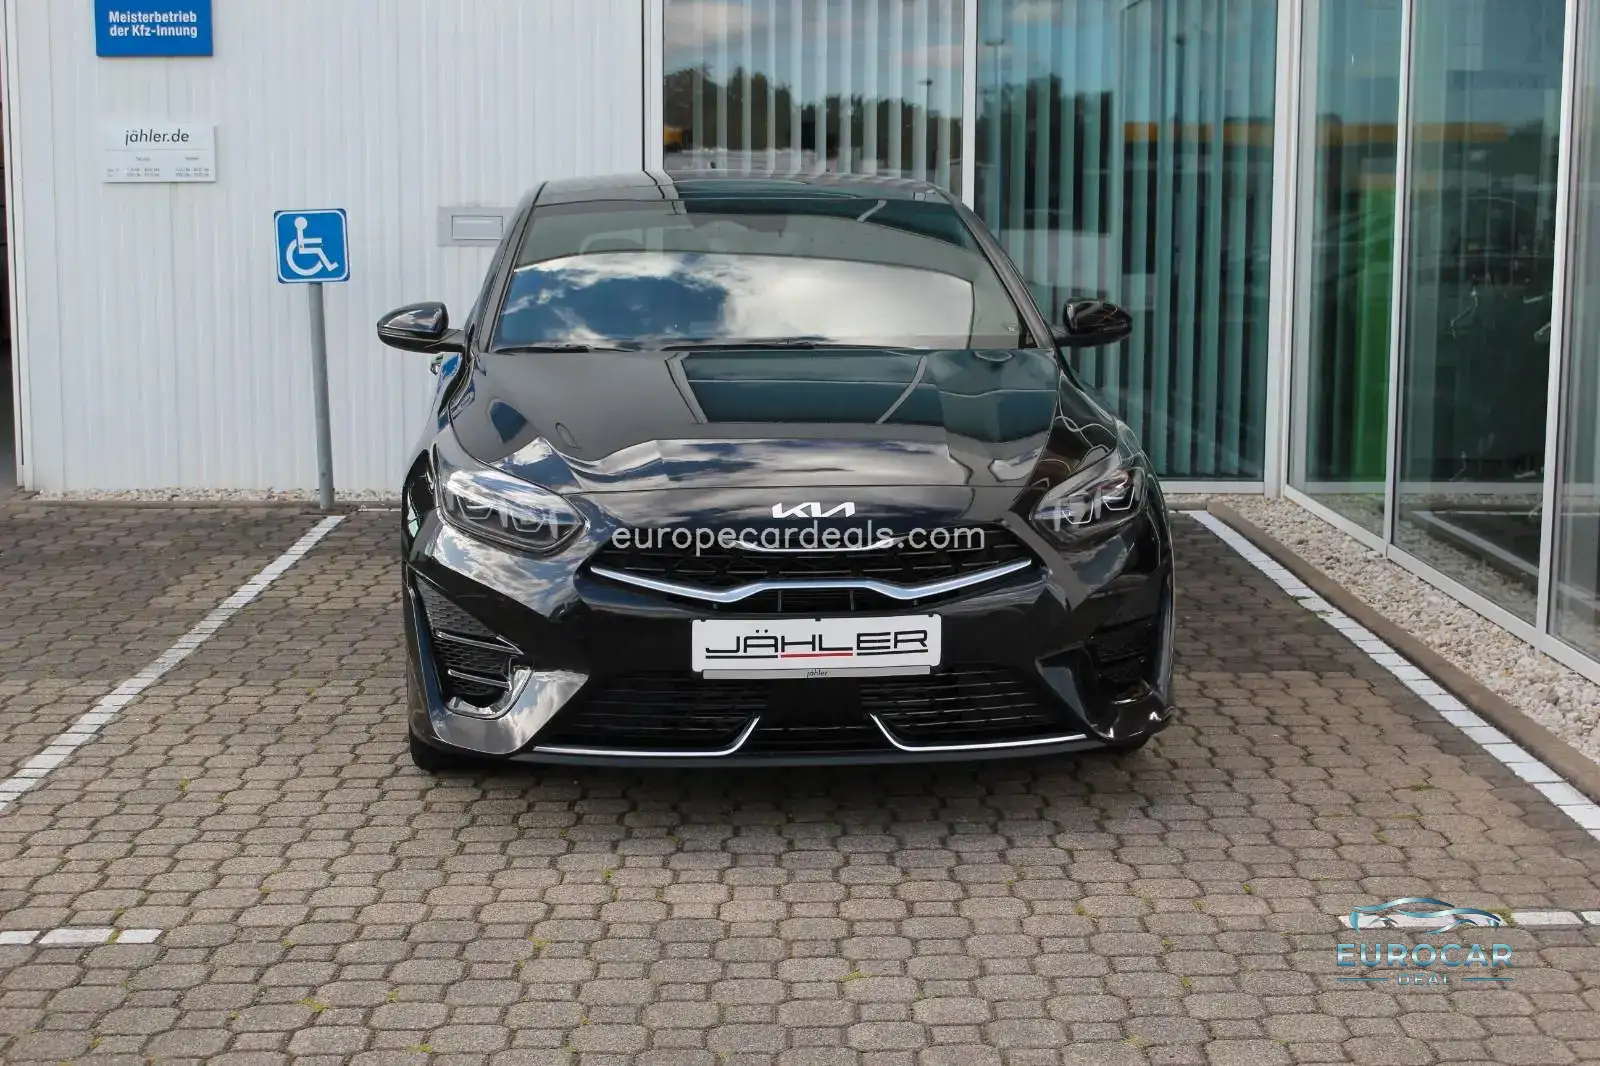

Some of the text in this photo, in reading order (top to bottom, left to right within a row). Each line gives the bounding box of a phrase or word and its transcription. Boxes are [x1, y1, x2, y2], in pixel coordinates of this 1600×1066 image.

[108, 11, 197, 23] Meisterbetrieb
[109, 25, 198, 38] der Kfz-Innung
[124, 128, 190, 146] jähler.de
[705, 628, 929, 655] JÄHLER
